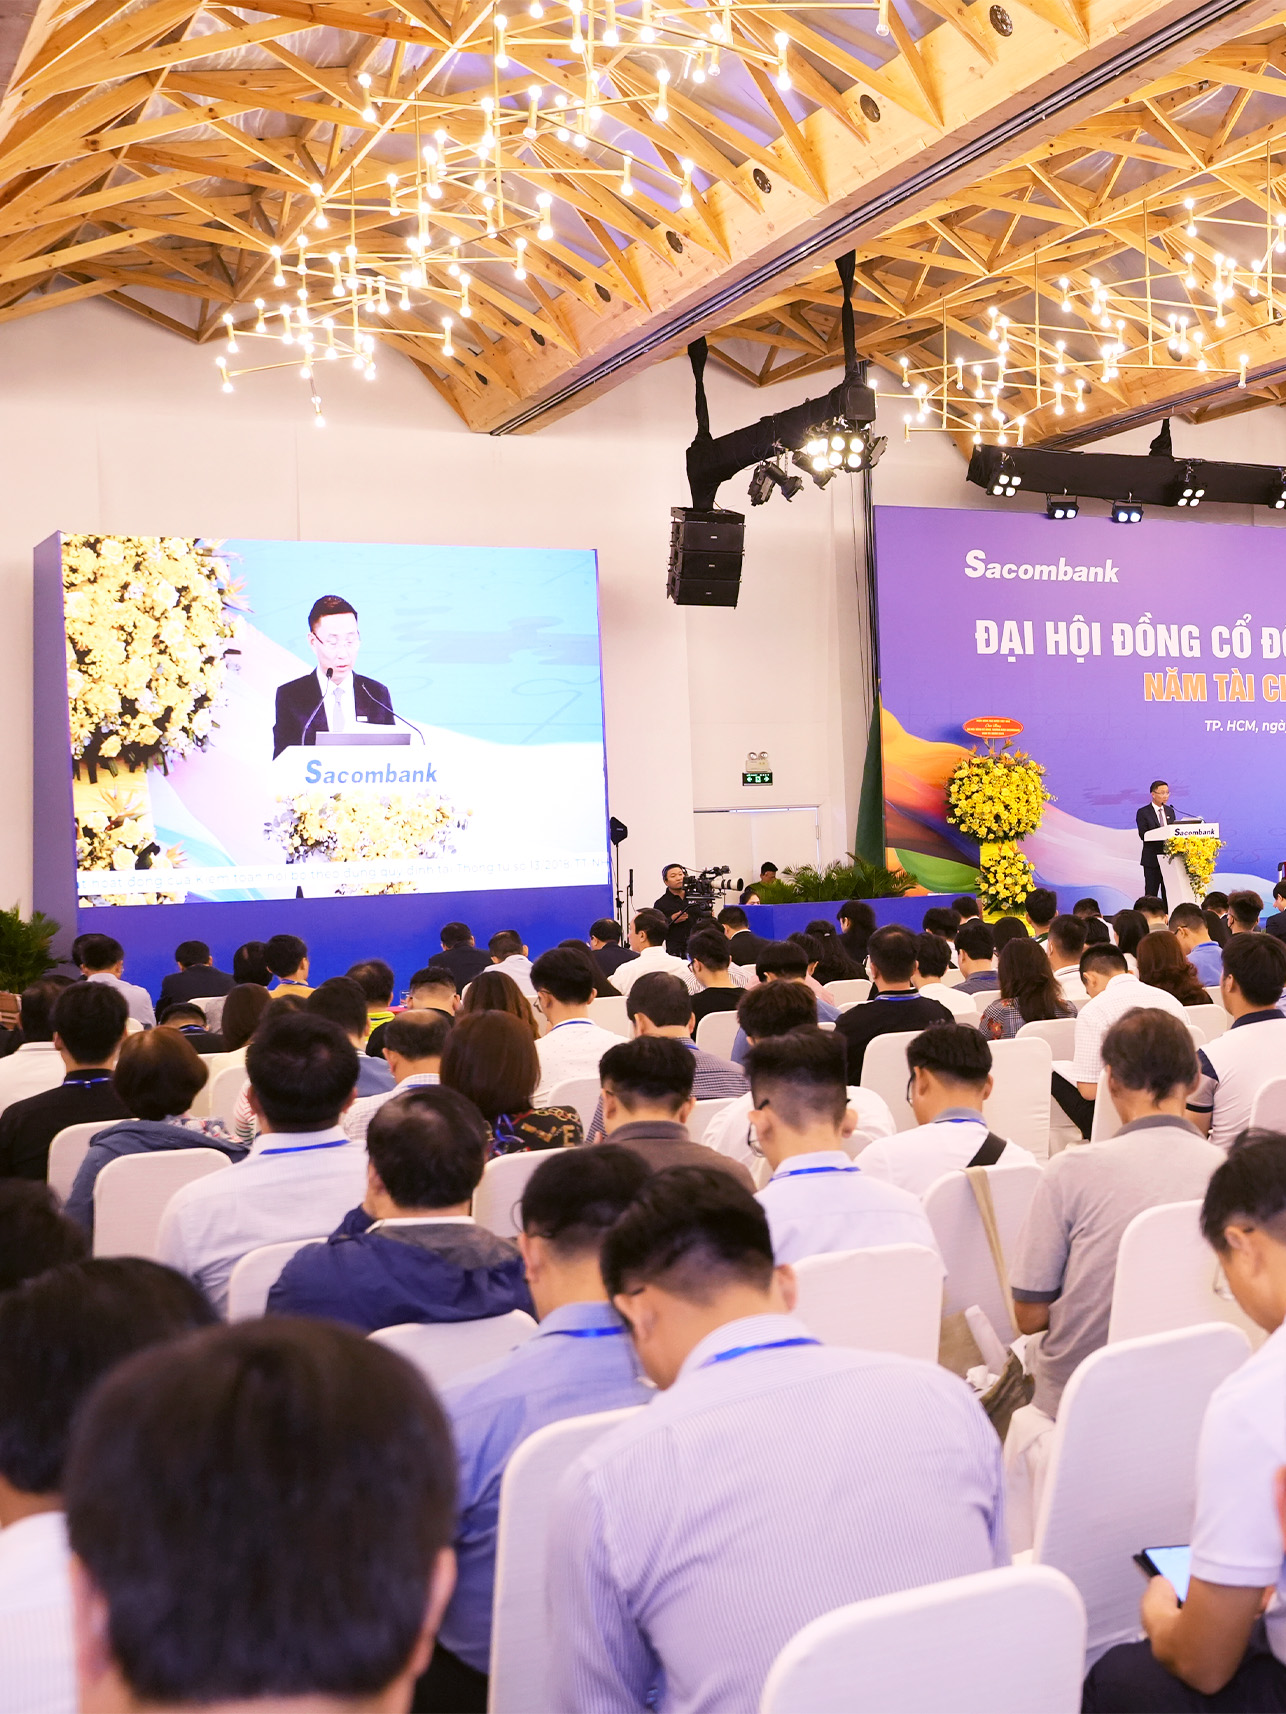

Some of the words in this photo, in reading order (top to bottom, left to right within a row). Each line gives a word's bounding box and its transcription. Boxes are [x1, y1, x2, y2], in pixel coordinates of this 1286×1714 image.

[965, 549, 1120, 583] Sacombank
[975, 620, 1034, 663] ĐẠI
[1046, 615, 1102, 663] HỘI
[1112, 612, 1201, 657] ĐỒNG
[1211, 613, 1252, 659] CỔ
[1144, 667, 1207, 701] NĂM
[1214, 668, 1255, 702] TÀI
[1204, 720, 1224, 732] TP.
[1226, 720, 1259, 734] HCM,
[304, 759, 438, 784] Sacombank
[1174, 828, 1215, 836] Sacombank
